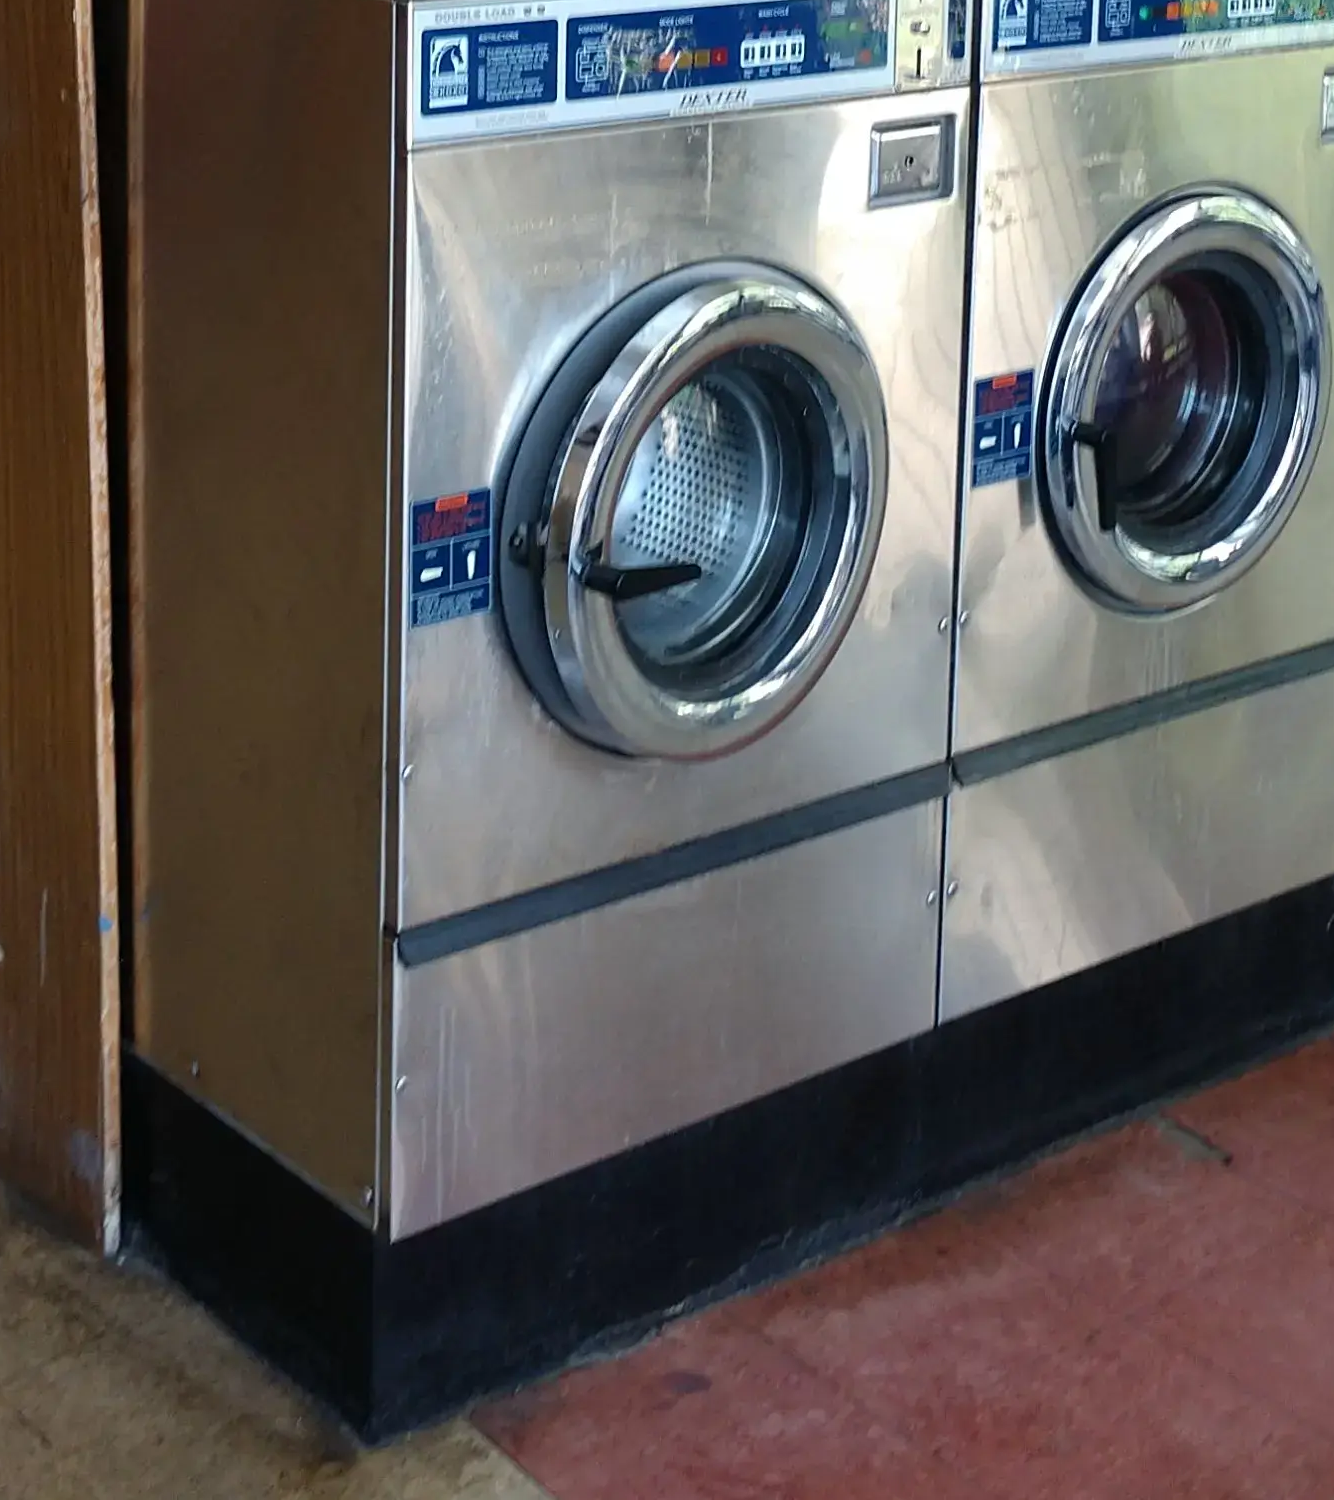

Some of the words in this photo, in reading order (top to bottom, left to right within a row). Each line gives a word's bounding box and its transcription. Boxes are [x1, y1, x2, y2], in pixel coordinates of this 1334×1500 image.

[434, 9, 481, 25] DOUBLE
[484, 6, 516, 20] LOAD
[1181, 36, 1233, 51] DEXTER
[680, 89, 748, 109] DEXTER
